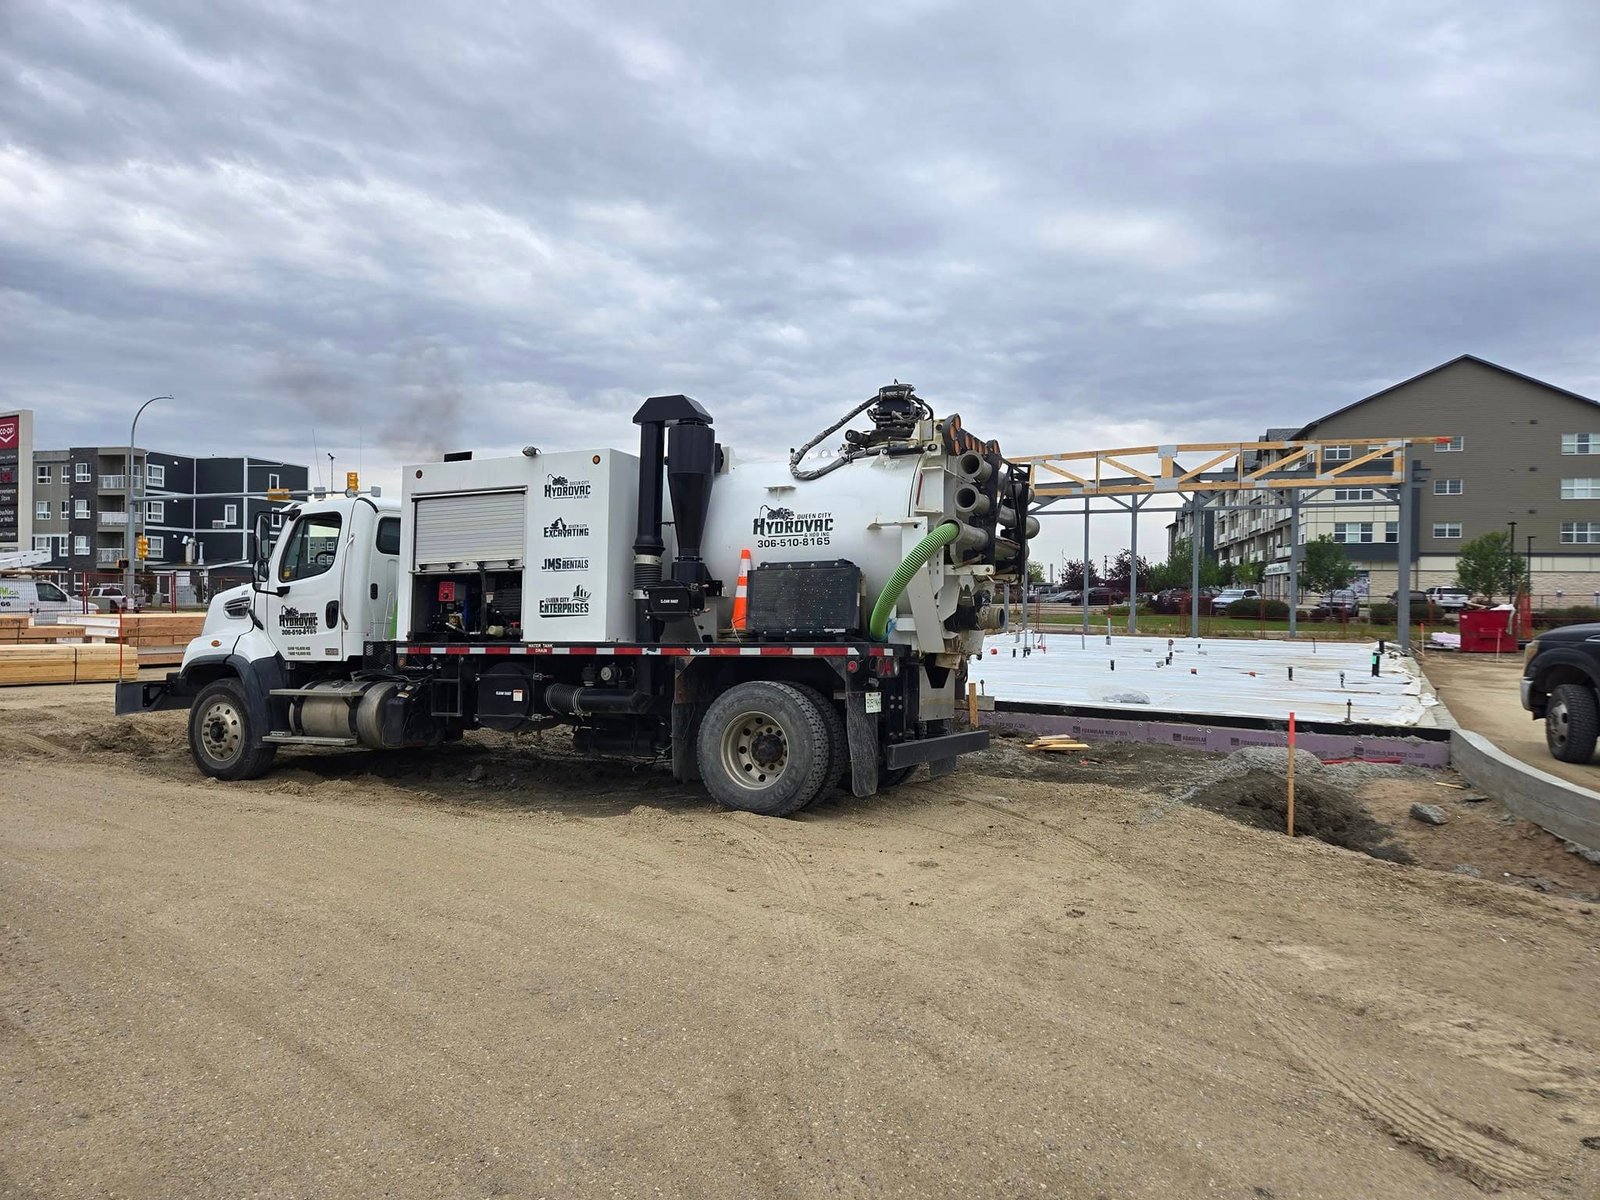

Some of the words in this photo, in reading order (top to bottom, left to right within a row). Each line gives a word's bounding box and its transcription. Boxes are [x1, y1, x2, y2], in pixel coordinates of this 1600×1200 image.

[544, 484, 591, 498] HYDROVAC
[543, 527, 589, 538] EXCAVATING
[753, 518, 834, 537] HYDROVAC
[757, 536, 831, 549] 306-510-8165
[541, 558, 561, 571] JMS
[562, 559, 589, 569] RENTALS
[539, 600, 589, 613] ENTERPRISES
[279, 615, 318, 628] HYDROVAC
